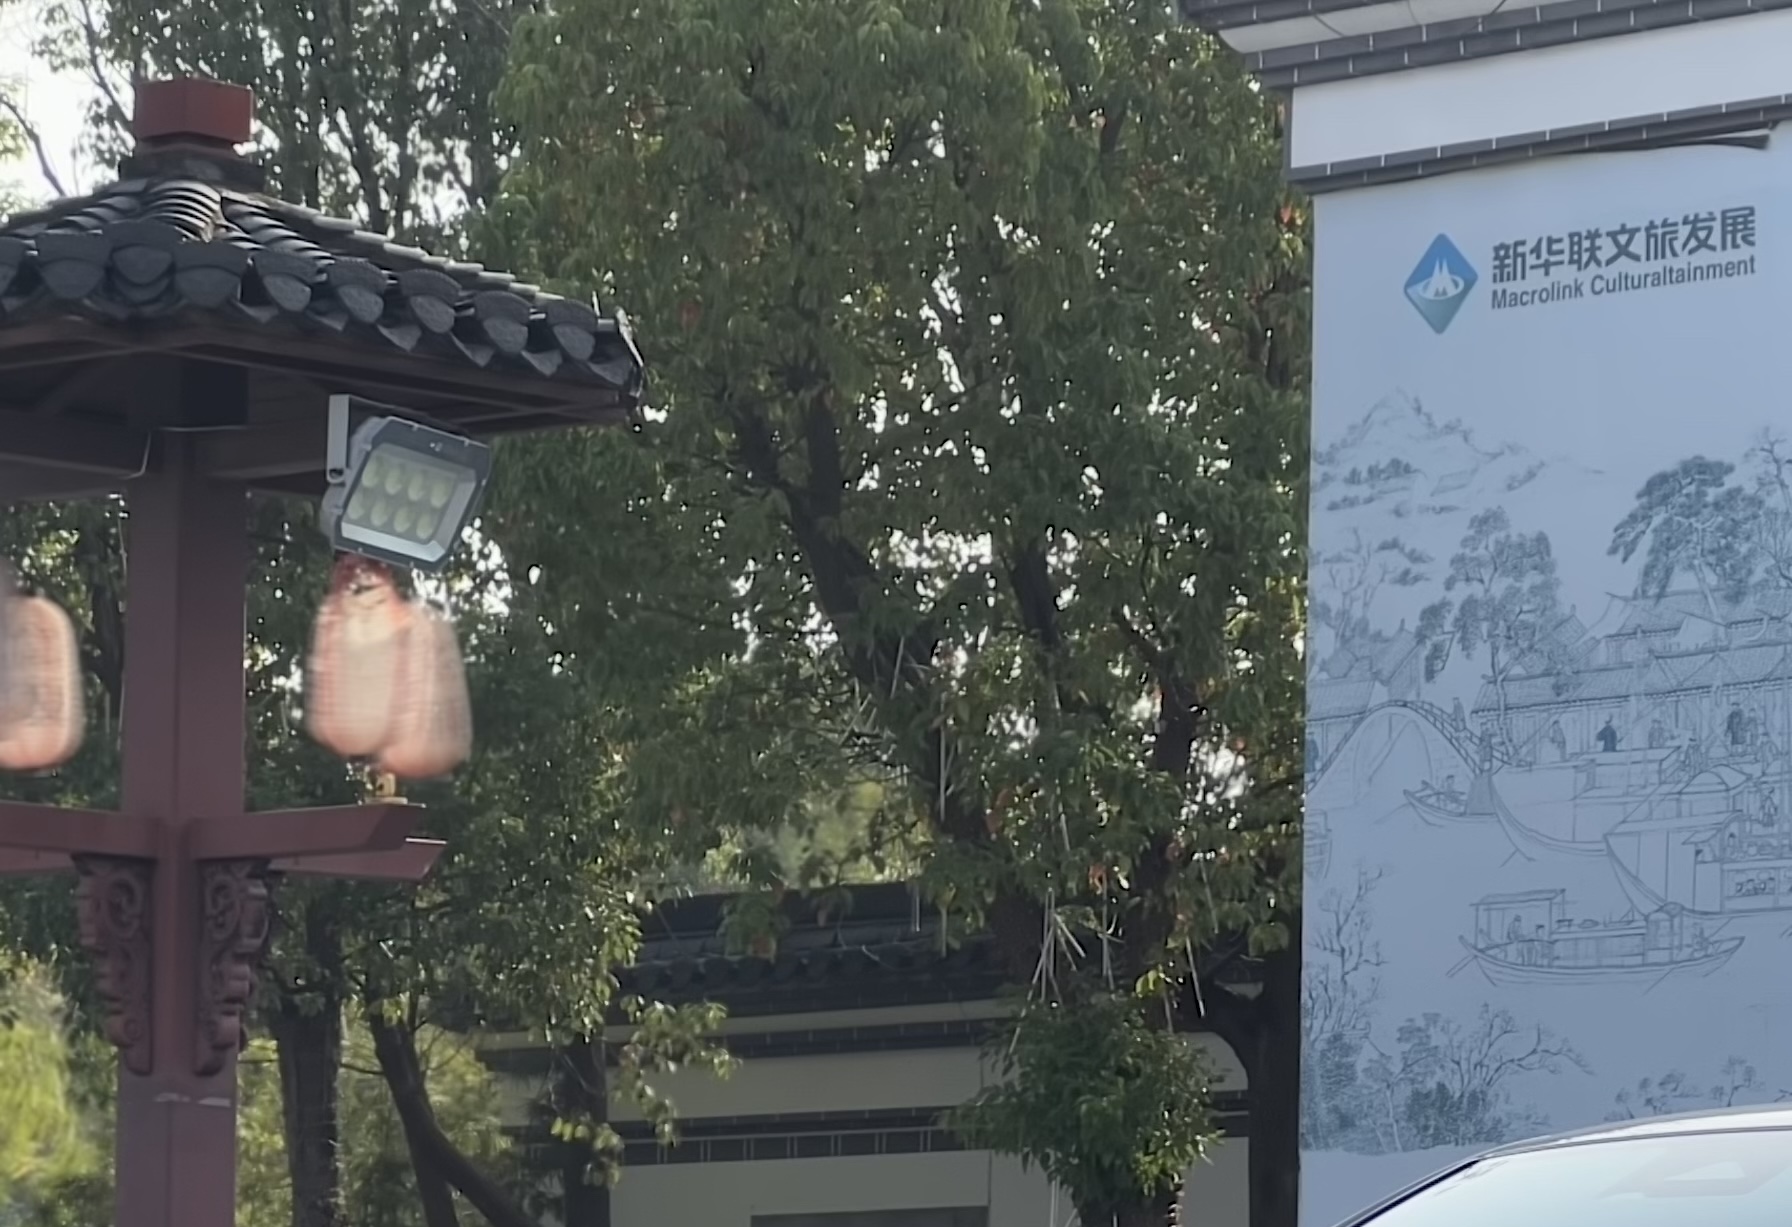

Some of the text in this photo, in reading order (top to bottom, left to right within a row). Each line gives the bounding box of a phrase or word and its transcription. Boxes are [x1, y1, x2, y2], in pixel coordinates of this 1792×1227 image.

[1492, 206, 1756, 283] 新华联文旅发展
[1491, 255, 1756, 310] Macrolink Culturaltainment
